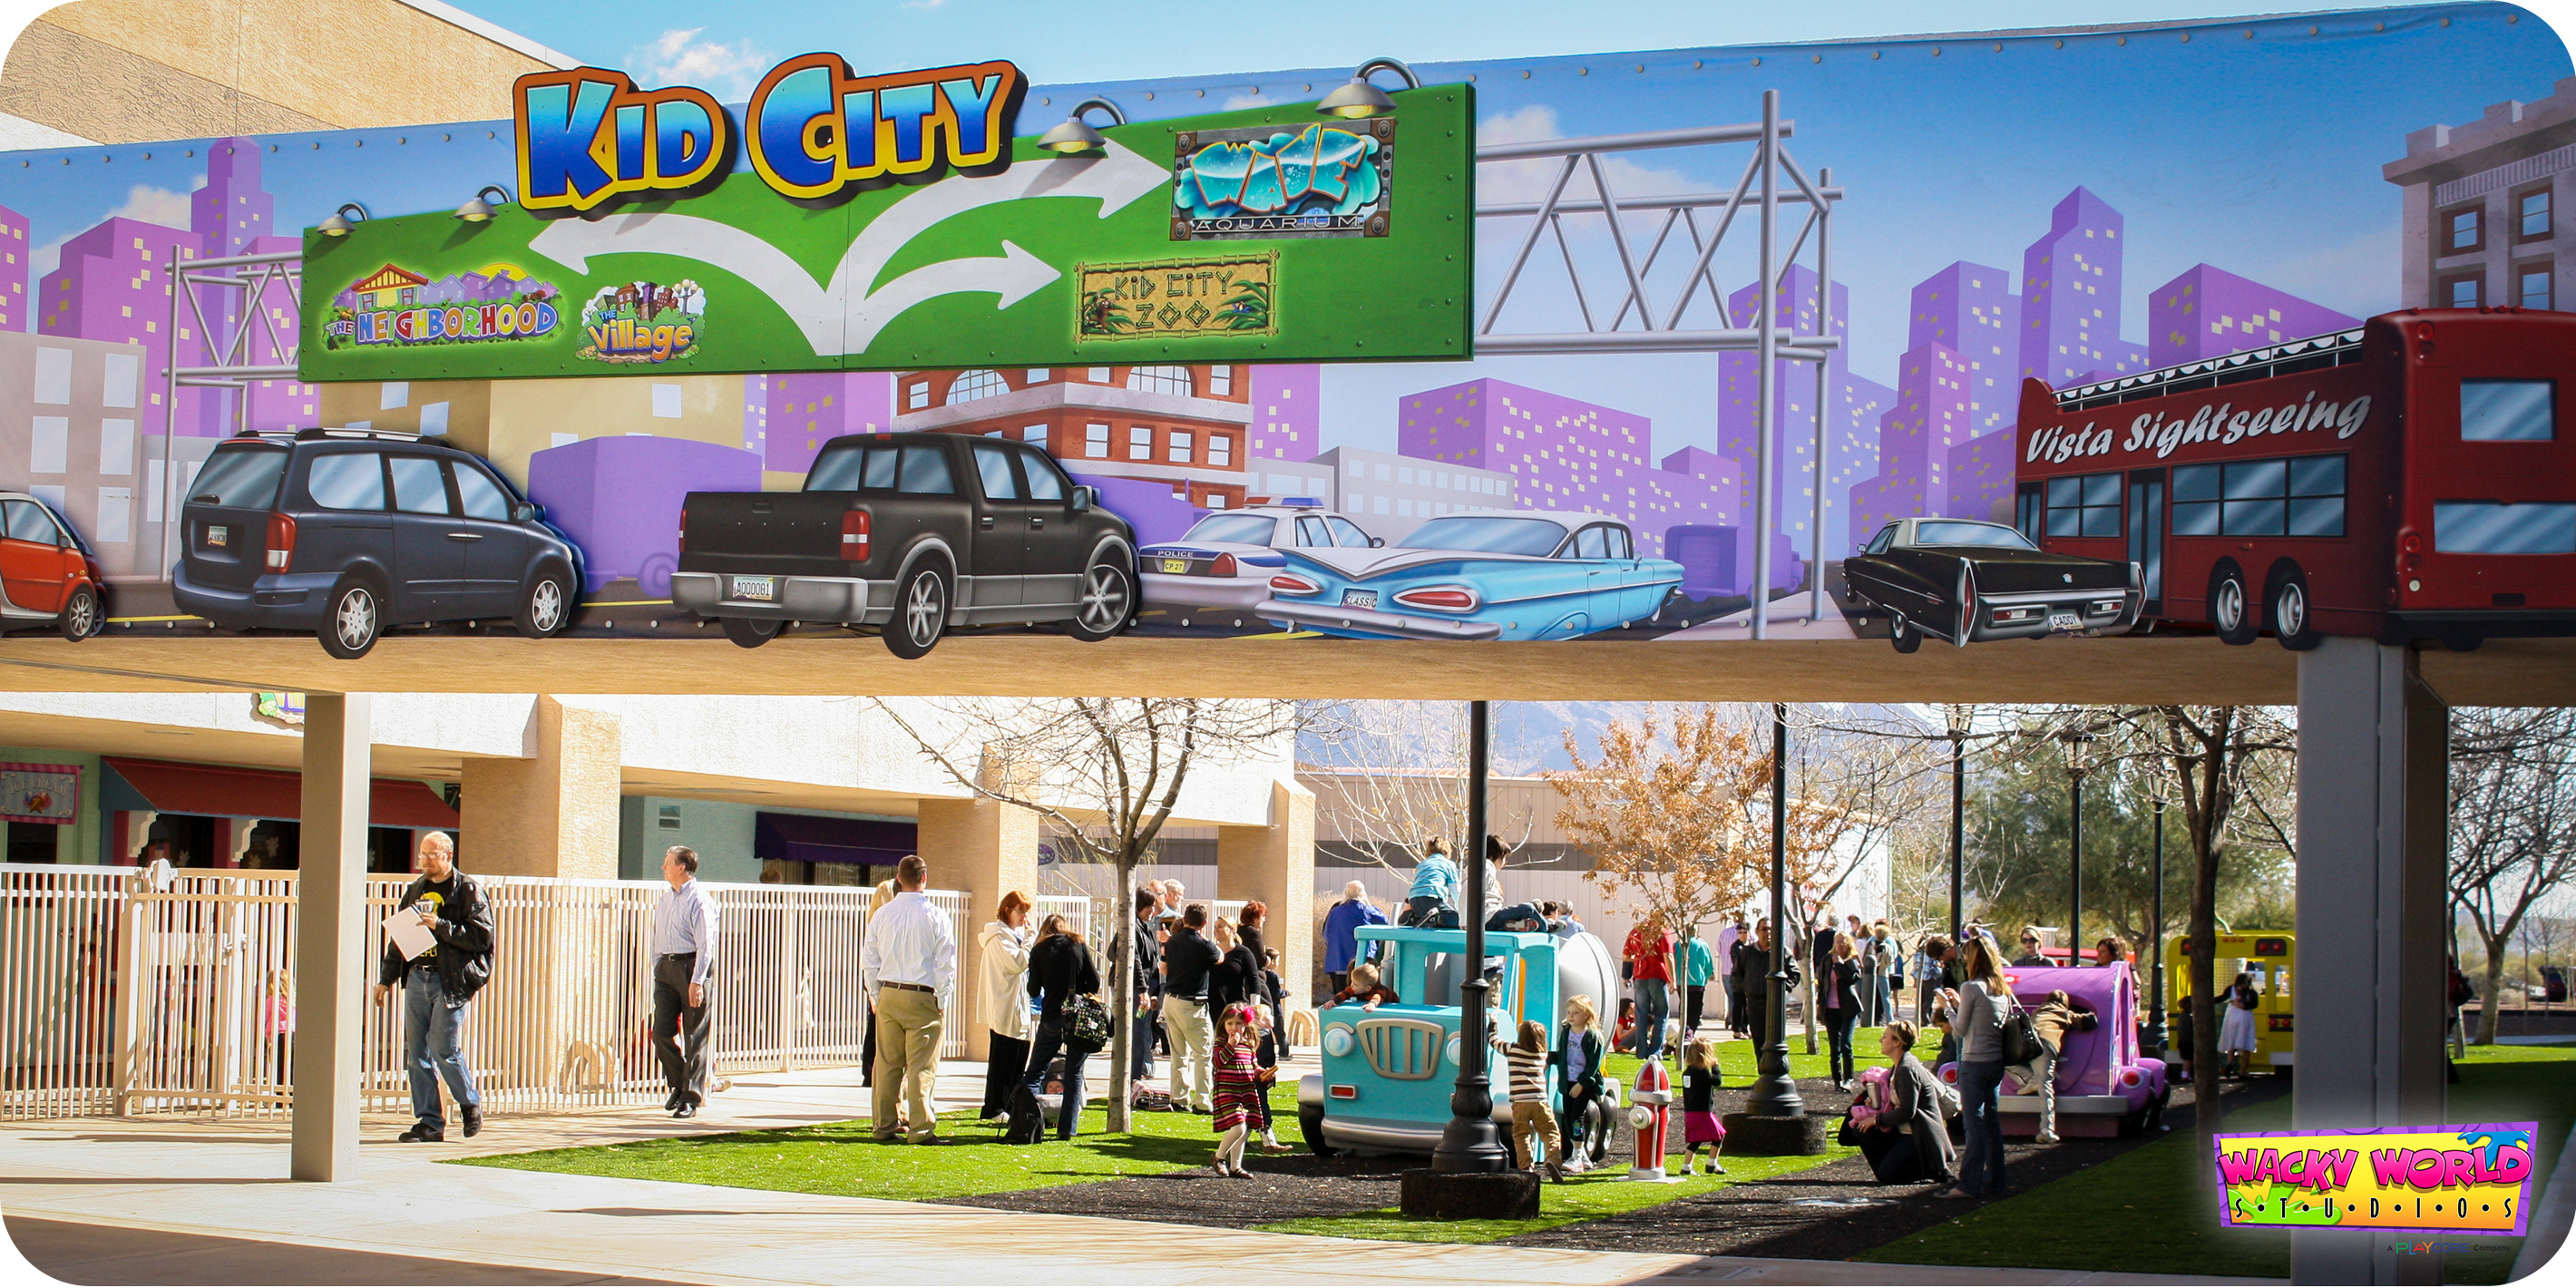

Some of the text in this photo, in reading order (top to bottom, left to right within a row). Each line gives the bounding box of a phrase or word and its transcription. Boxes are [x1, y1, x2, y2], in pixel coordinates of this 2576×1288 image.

[525, 65, 1004, 200] KID CITY
[1195, 216, 1359, 230] AQUARIUM
[326, 302, 558, 343] THE NEIGHBORHOOD
[599, 310, 617, 321] THE
[1134, 301, 1211, 328] ZOO
[587, 318, 695, 361] Village
[2026, 391, 2371, 463] Vista Sightseeing
[1157, 550, 1194, 558] POLICE
[2053, 614, 2078, 627] CADDY
